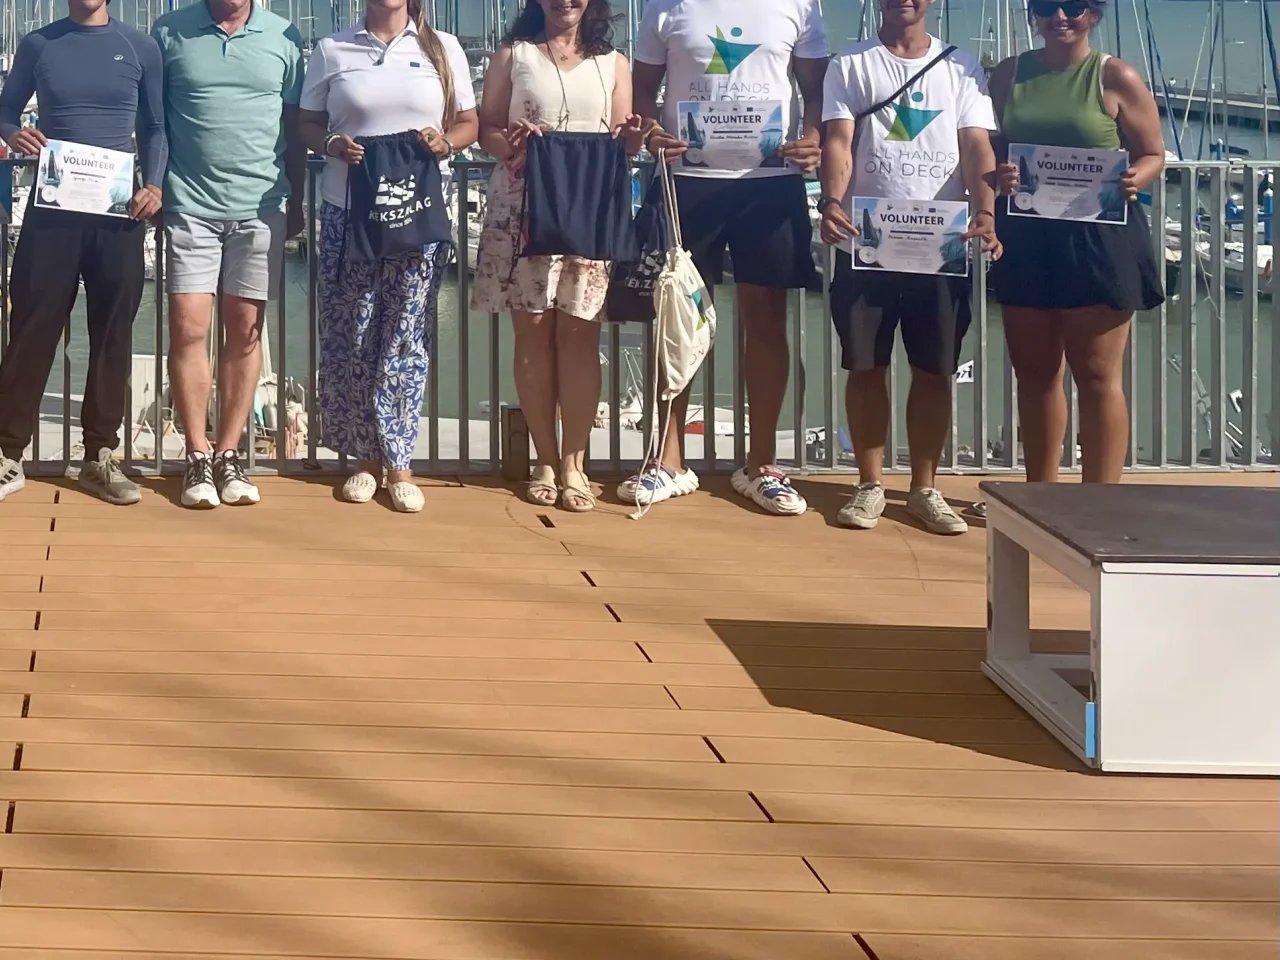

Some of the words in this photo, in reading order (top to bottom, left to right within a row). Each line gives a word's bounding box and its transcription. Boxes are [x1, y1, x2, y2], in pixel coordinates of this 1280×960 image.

[689, 82, 712, 93] ALL
[719, 81, 770, 94] HANDS
[702, 114, 762, 124] VOLUNTEER
[63, 155, 115, 170] VOLUNTEER
[899, 149, 956, 164] HANDS
[864, 160, 892, 174] ON
[901, 163, 954, 179] DECK
[1037, 160, 1104, 173] VOLUNTEER
[879, 213, 945, 226] VOLUNTEER
